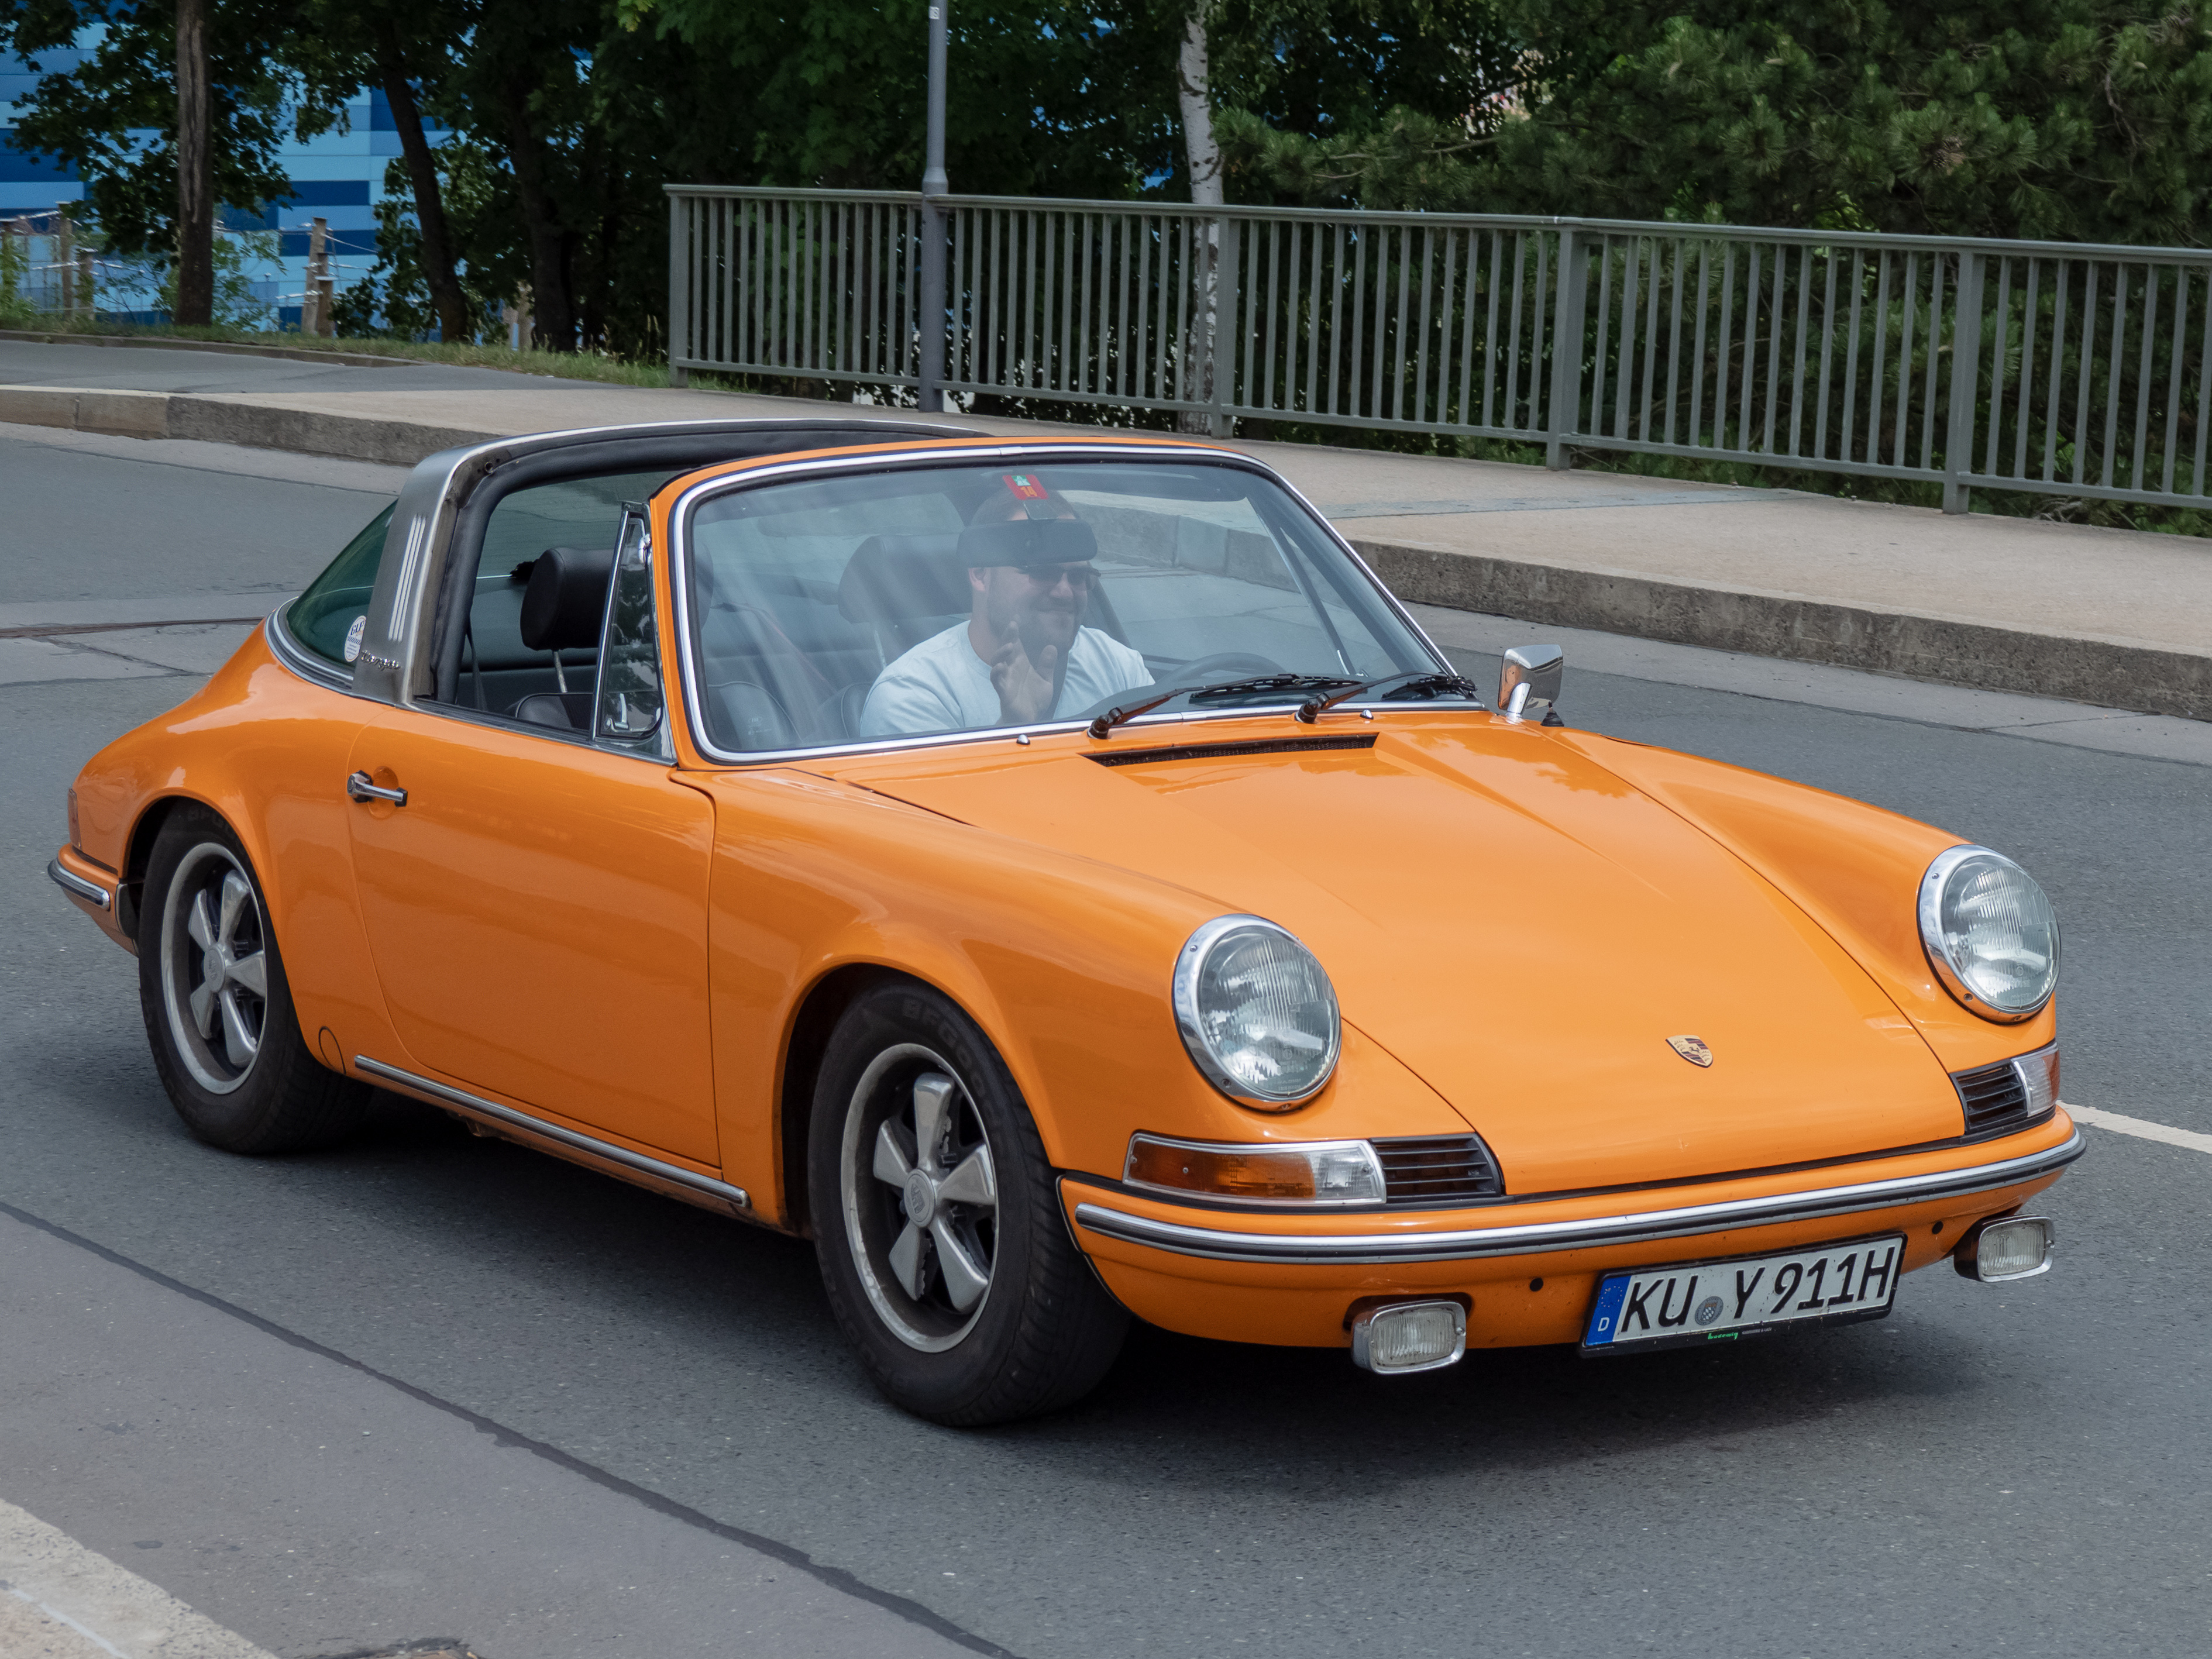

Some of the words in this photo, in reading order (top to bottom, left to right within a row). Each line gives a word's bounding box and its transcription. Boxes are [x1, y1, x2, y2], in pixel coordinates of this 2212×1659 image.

[1020, 486, 1038, 497] 14
[1621, 1275, 1698, 1333] KU
[1733, 1267, 1766, 1319] Y
[1770, 1246, 1895, 1314] 911H
[1597, 1317, 1610, 1332] D
